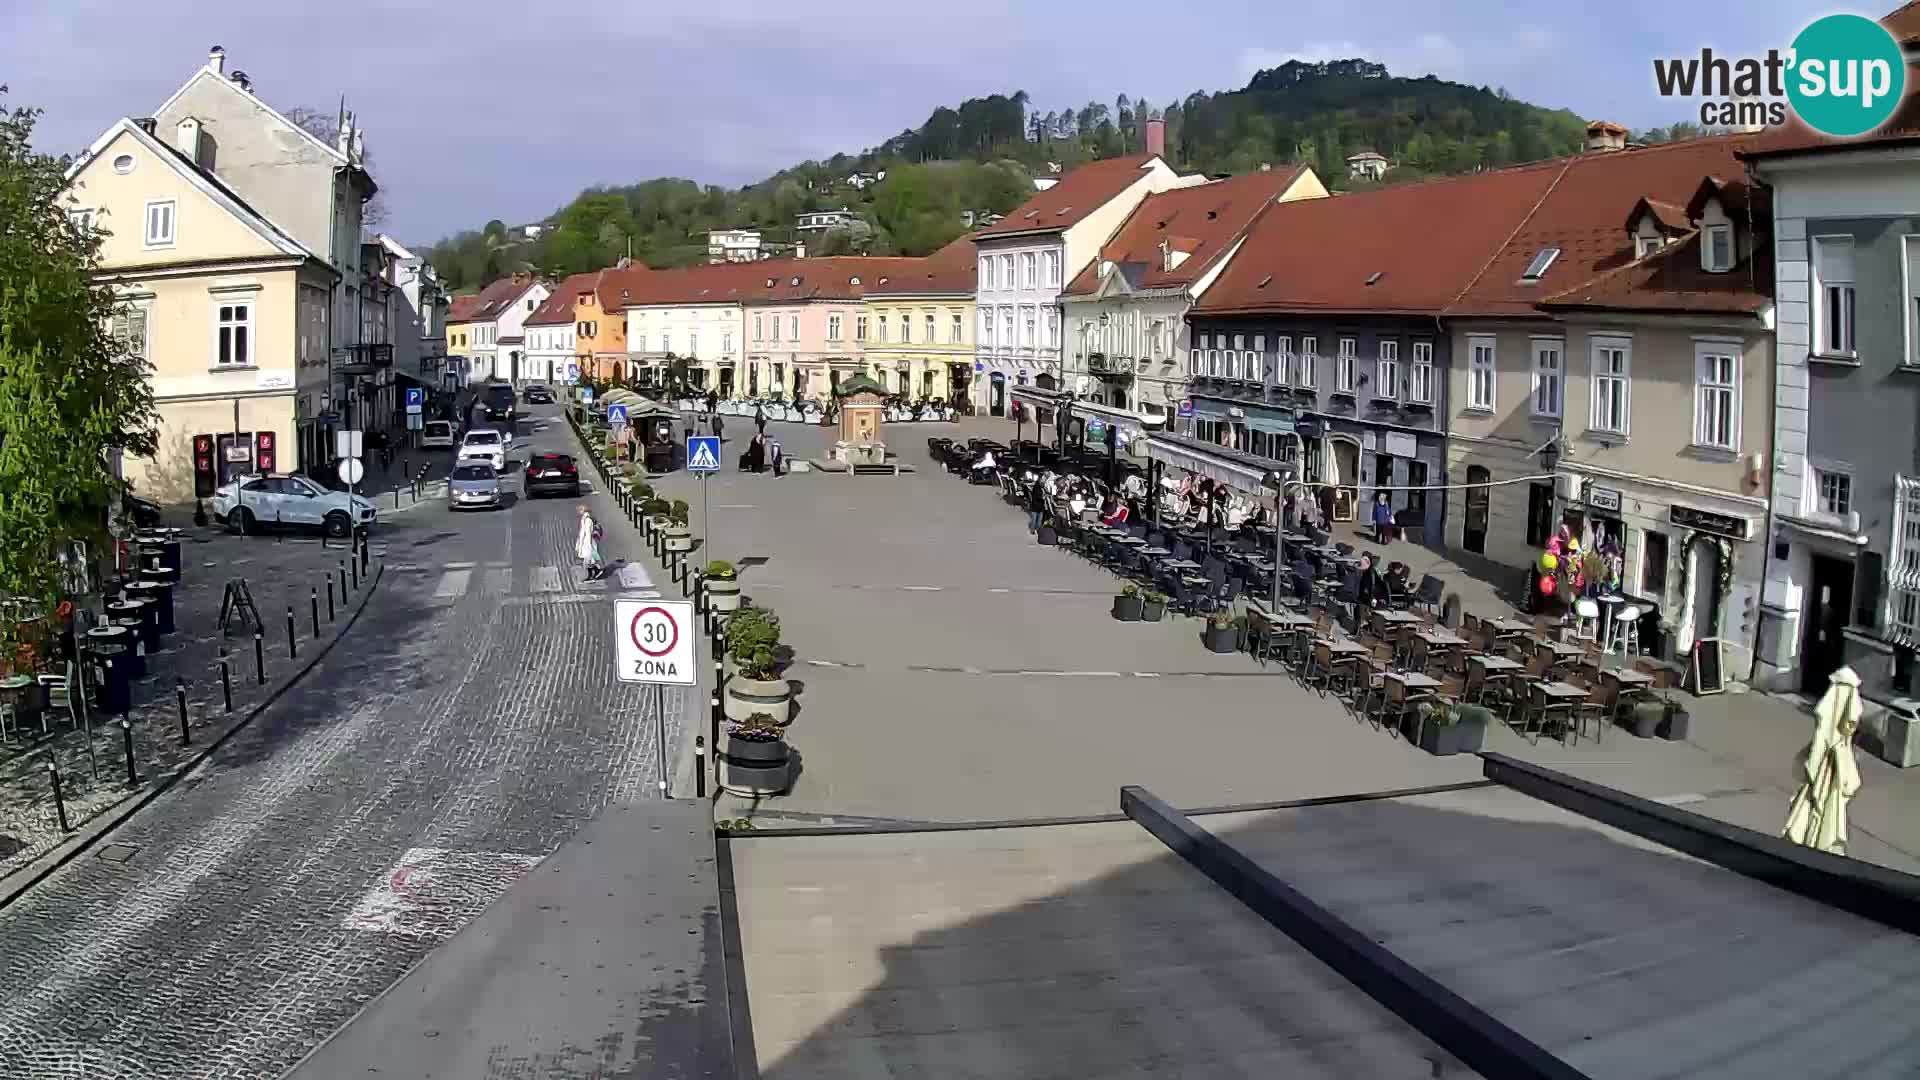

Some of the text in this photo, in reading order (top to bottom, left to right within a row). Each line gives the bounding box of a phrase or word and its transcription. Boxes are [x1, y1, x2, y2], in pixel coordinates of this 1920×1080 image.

[410, 392, 418, 402] P
[643, 622, 667, 643] 30
[633, 659, 677, 677] ZONA
